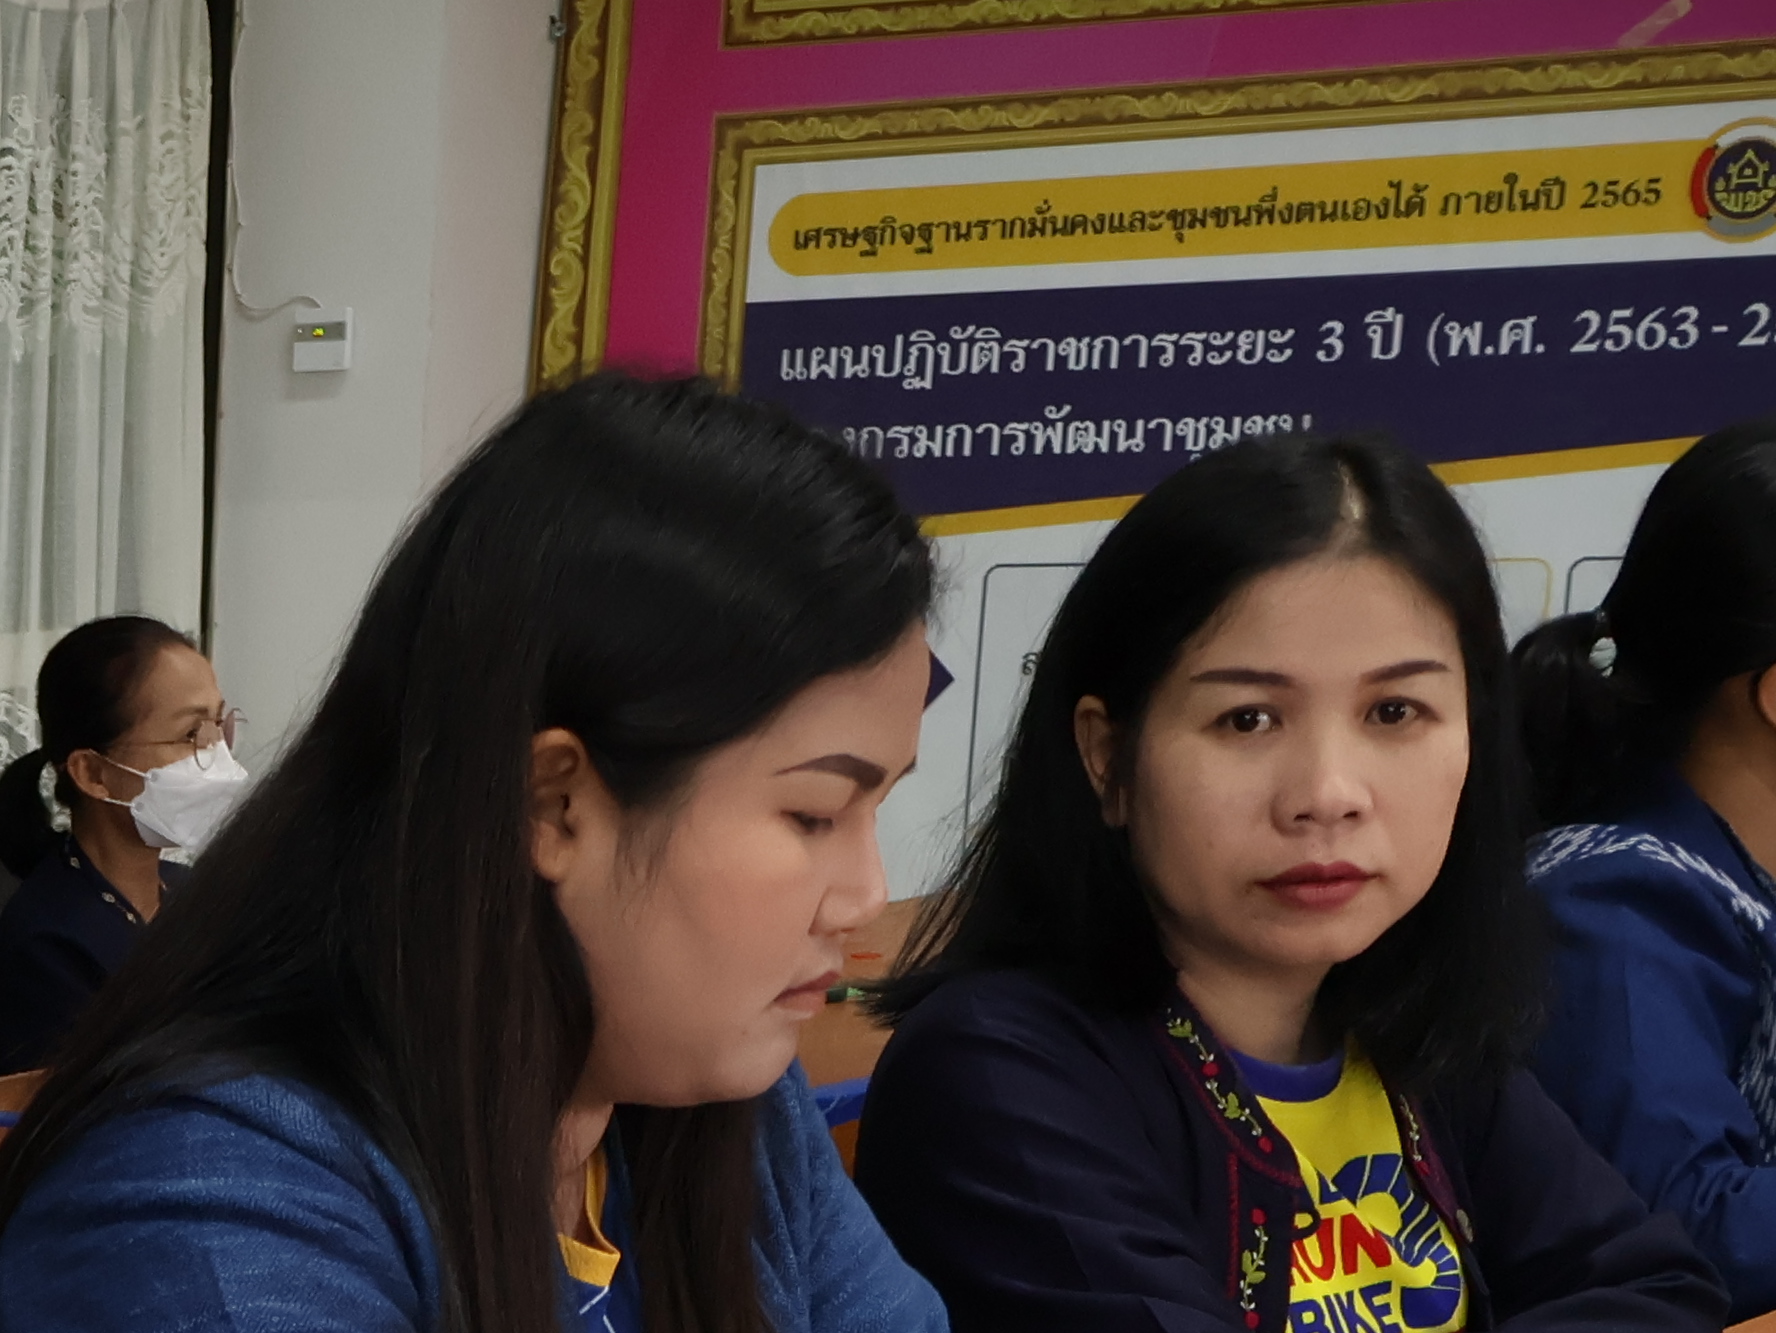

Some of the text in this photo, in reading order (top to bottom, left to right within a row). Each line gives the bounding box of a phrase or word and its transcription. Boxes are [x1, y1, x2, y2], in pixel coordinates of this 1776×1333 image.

[792, 172, 1663, 257] เศรษฐกิจฐานรากมั่นคงและชุมชนพึ่งตนเองได้ ภายในปี 2565
[779, 325, 1296, 391] แผนปฏิบัติราชการระยะ
[1315, 319, 1346, 363] 3
[1363, 307, 1405, 361] ปี
[1426, 312, 1547, 367] (พ.ศ.
